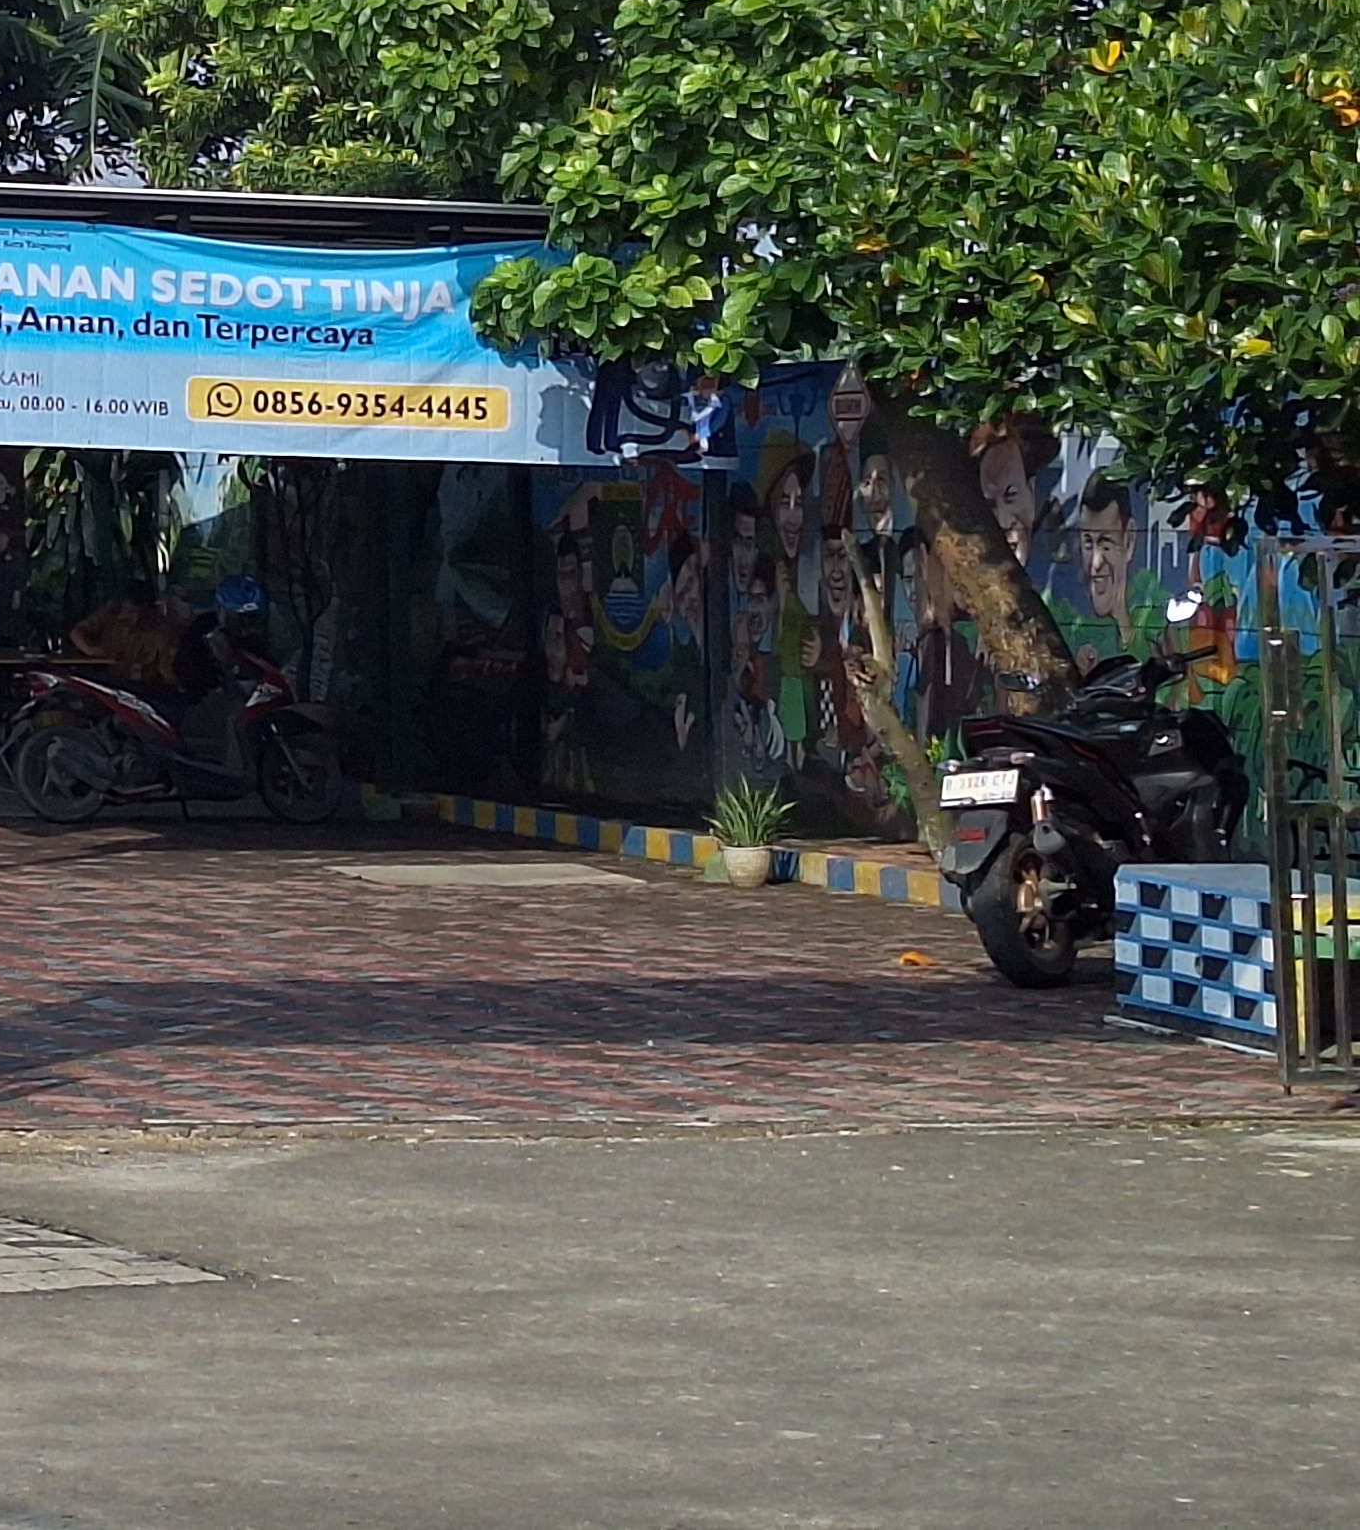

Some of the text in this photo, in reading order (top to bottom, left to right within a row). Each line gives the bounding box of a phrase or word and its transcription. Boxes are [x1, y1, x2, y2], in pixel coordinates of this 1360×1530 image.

[149, 273, 312, 313] SEDOT
[317, 277, 455, 321] TINJA
[132, 311, 192, 339] dan
[195, 313, 376, 351] Terpercaya
[85, 398, 130, 415] 16.00
[133, 399, 170, 417] WIB
[252, 389, 490, 422] 0856-9354-4445
